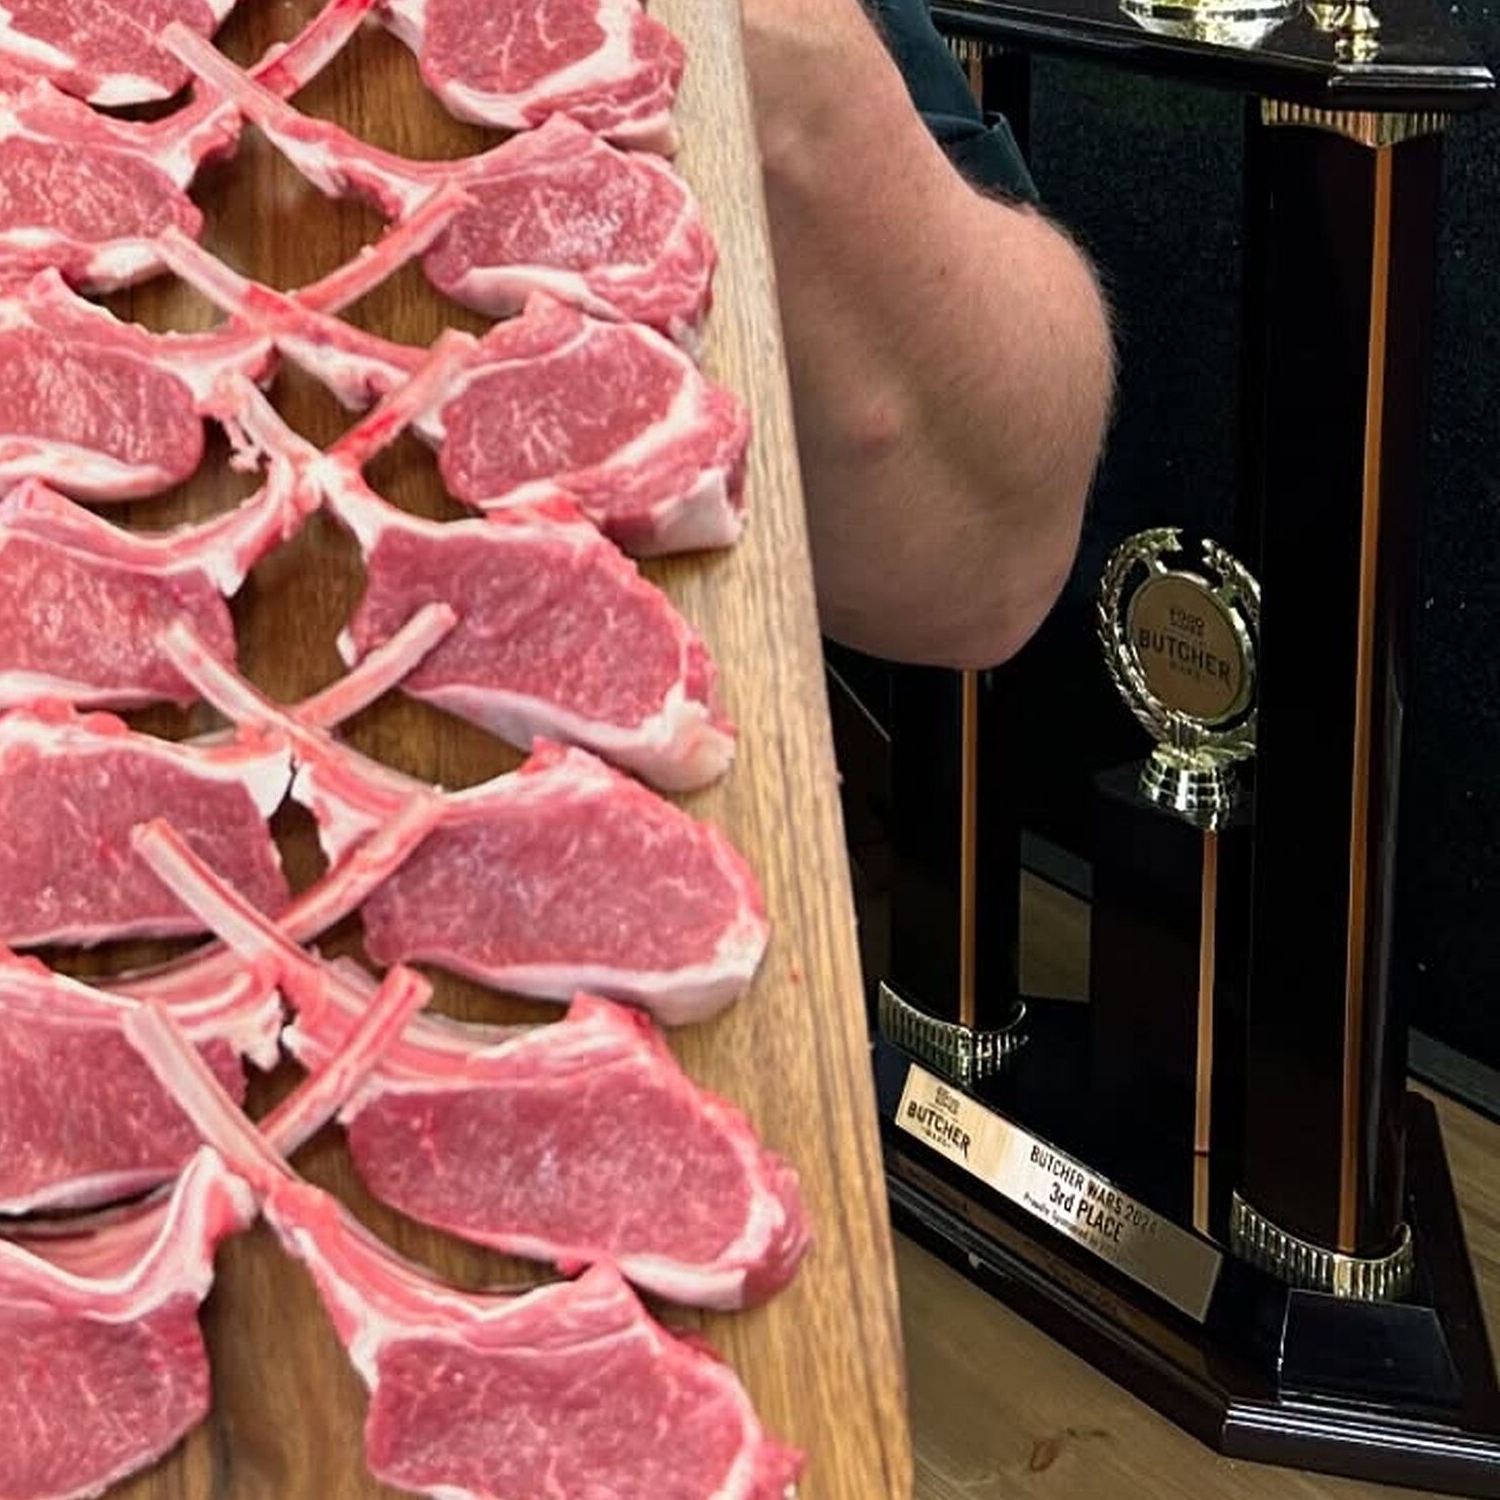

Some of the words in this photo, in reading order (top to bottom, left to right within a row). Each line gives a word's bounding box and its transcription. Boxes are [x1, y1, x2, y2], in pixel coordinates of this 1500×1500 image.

[1138, 626, 1234, 695] BUTCHER
[906, 1100, 971, 1160] BUTCHER
[1030, 1144, 1086, 1192] BUTCHER
[1086, 1179, 1122, 1215] WARS
[1049, 1181, 1076, 1213] 3rd
[1076, 1198, 1125, 1243] PLACE
